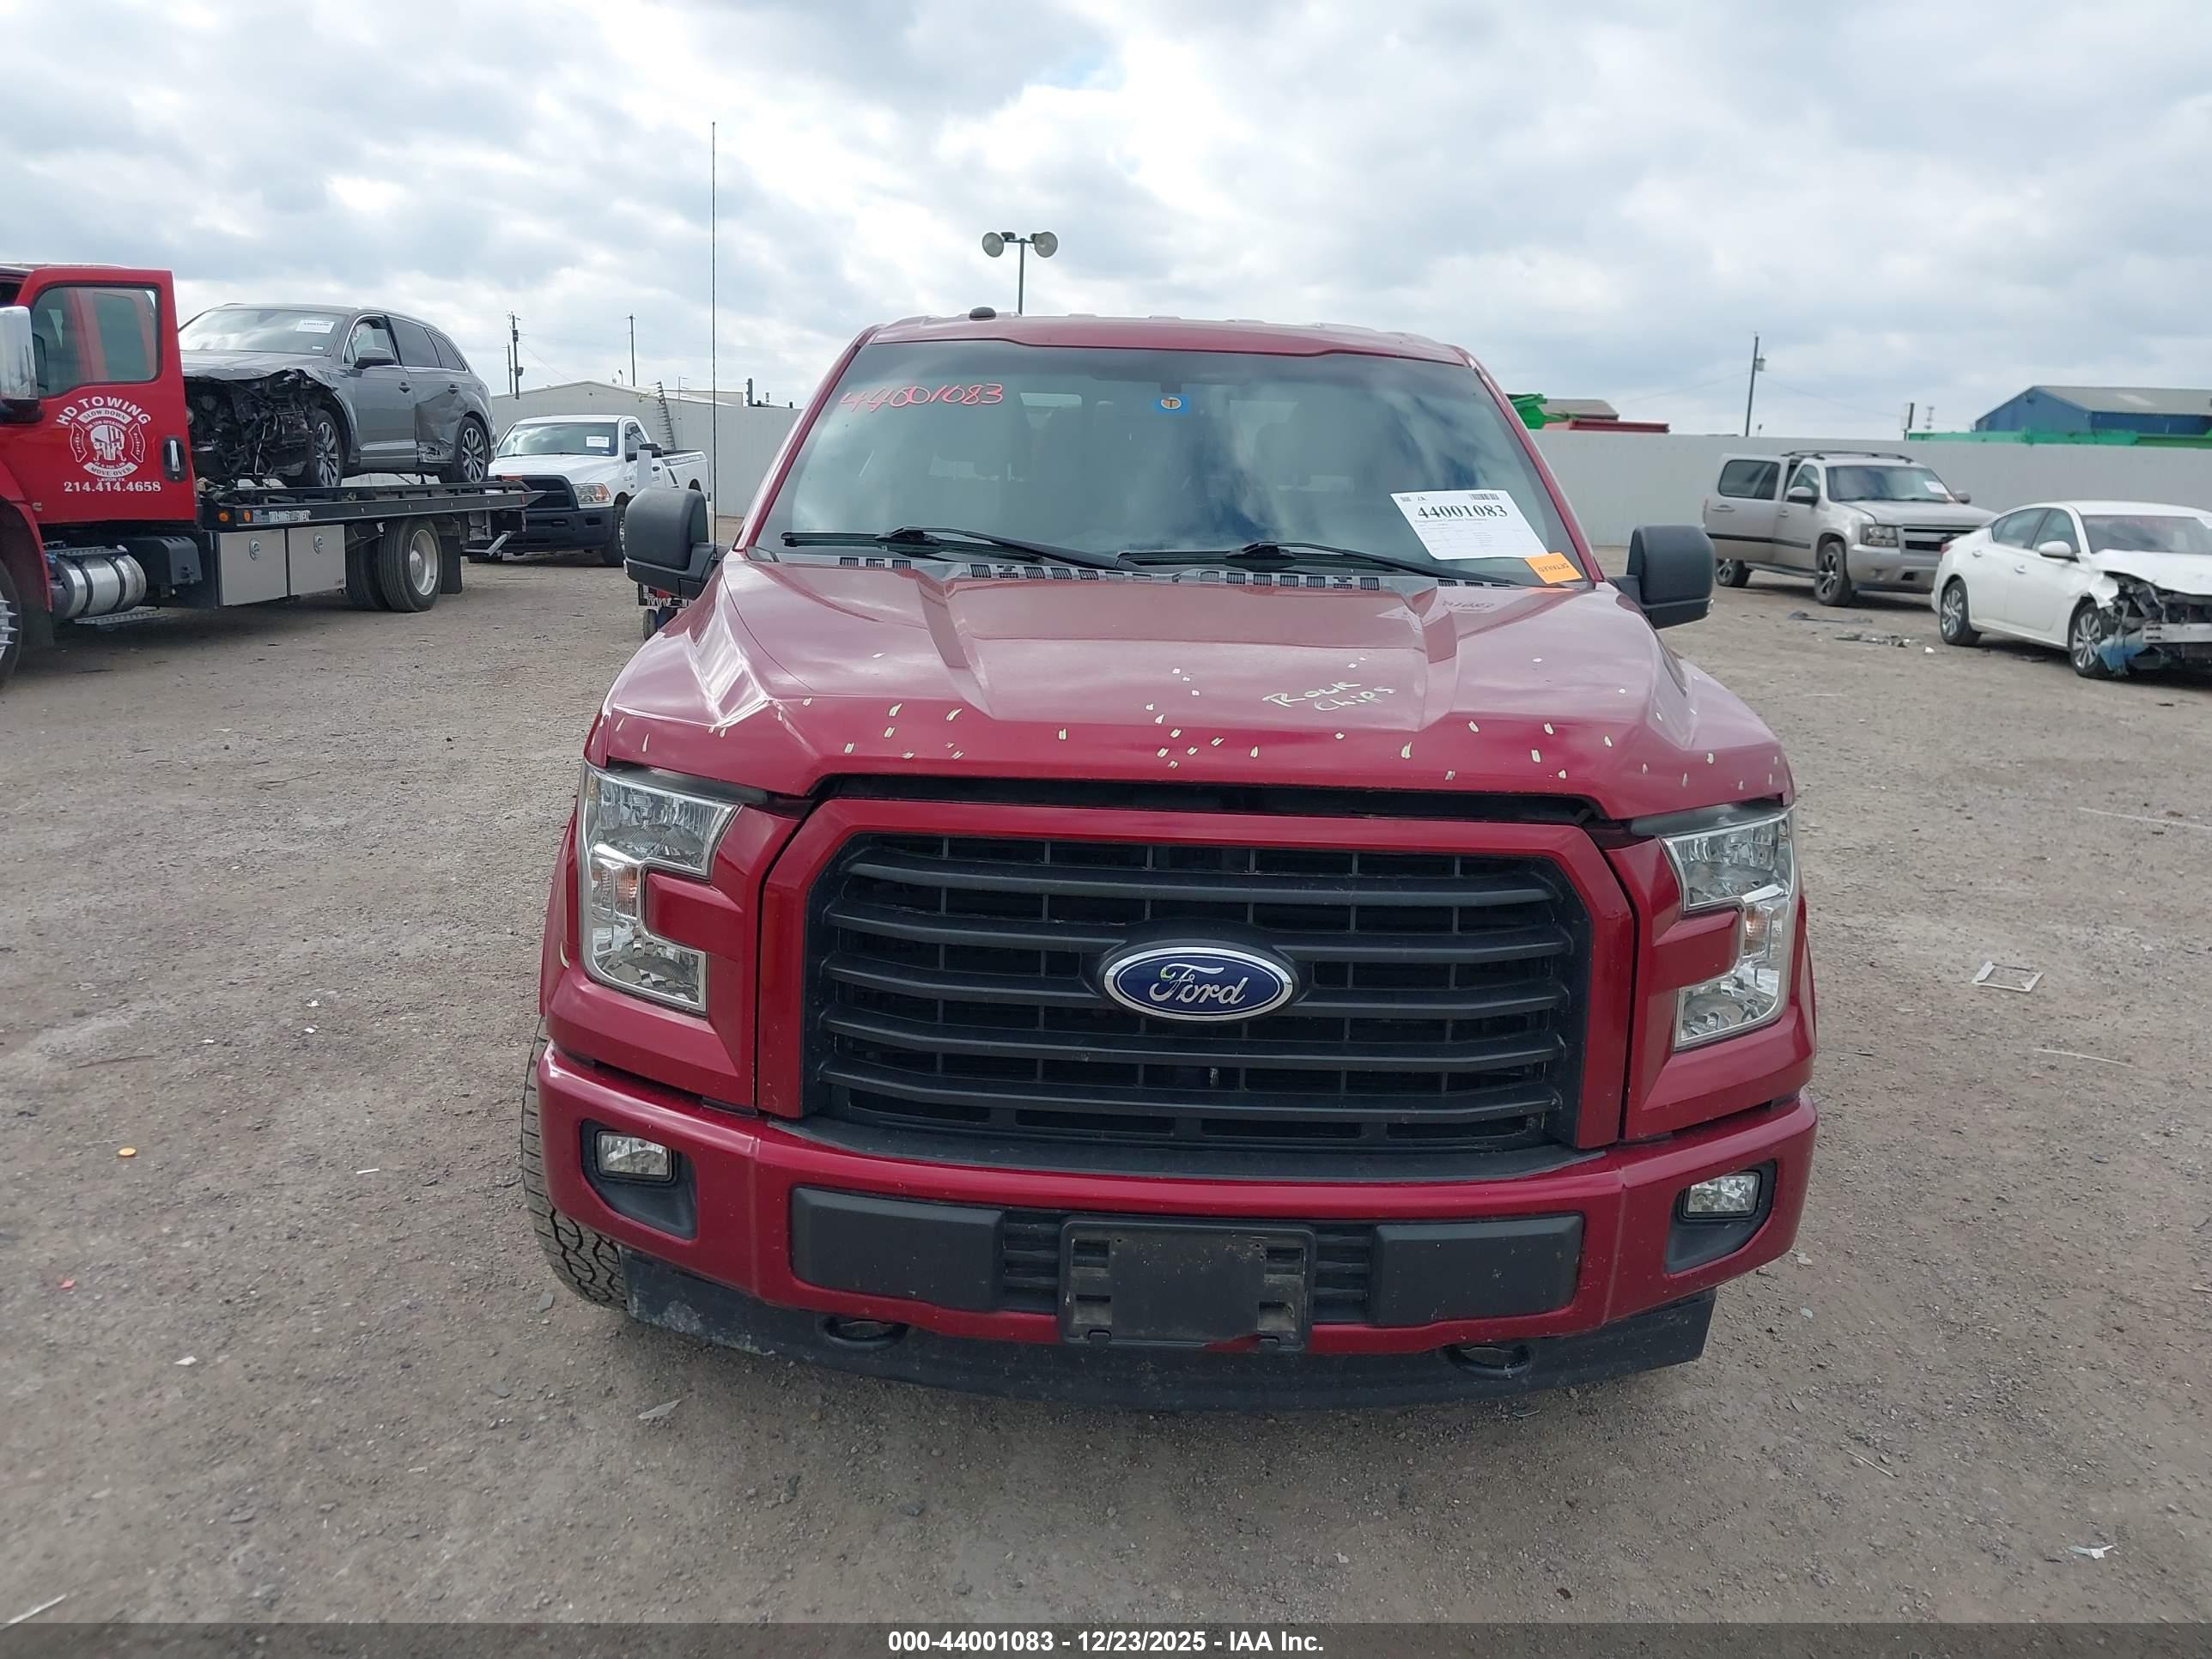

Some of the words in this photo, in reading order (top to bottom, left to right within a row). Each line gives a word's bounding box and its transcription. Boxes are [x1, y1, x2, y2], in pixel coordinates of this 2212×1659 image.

[839, 383, 1004, 413] 44001083
[56, 406, 78, 425] HD
[78, 396, 151, 424] TOWING
[83, 410, 103, 420] SLOW
[104, 410, 126, 420] DOWN
[90, 466, 111, 476] MOVE
[112, 465, 131, 476] OVER
[64, 481, 161, 492] 214.414.4658
[1418, 504, 1508, 518] 44001083
[1149, 963, 1249, 1005] Ford
